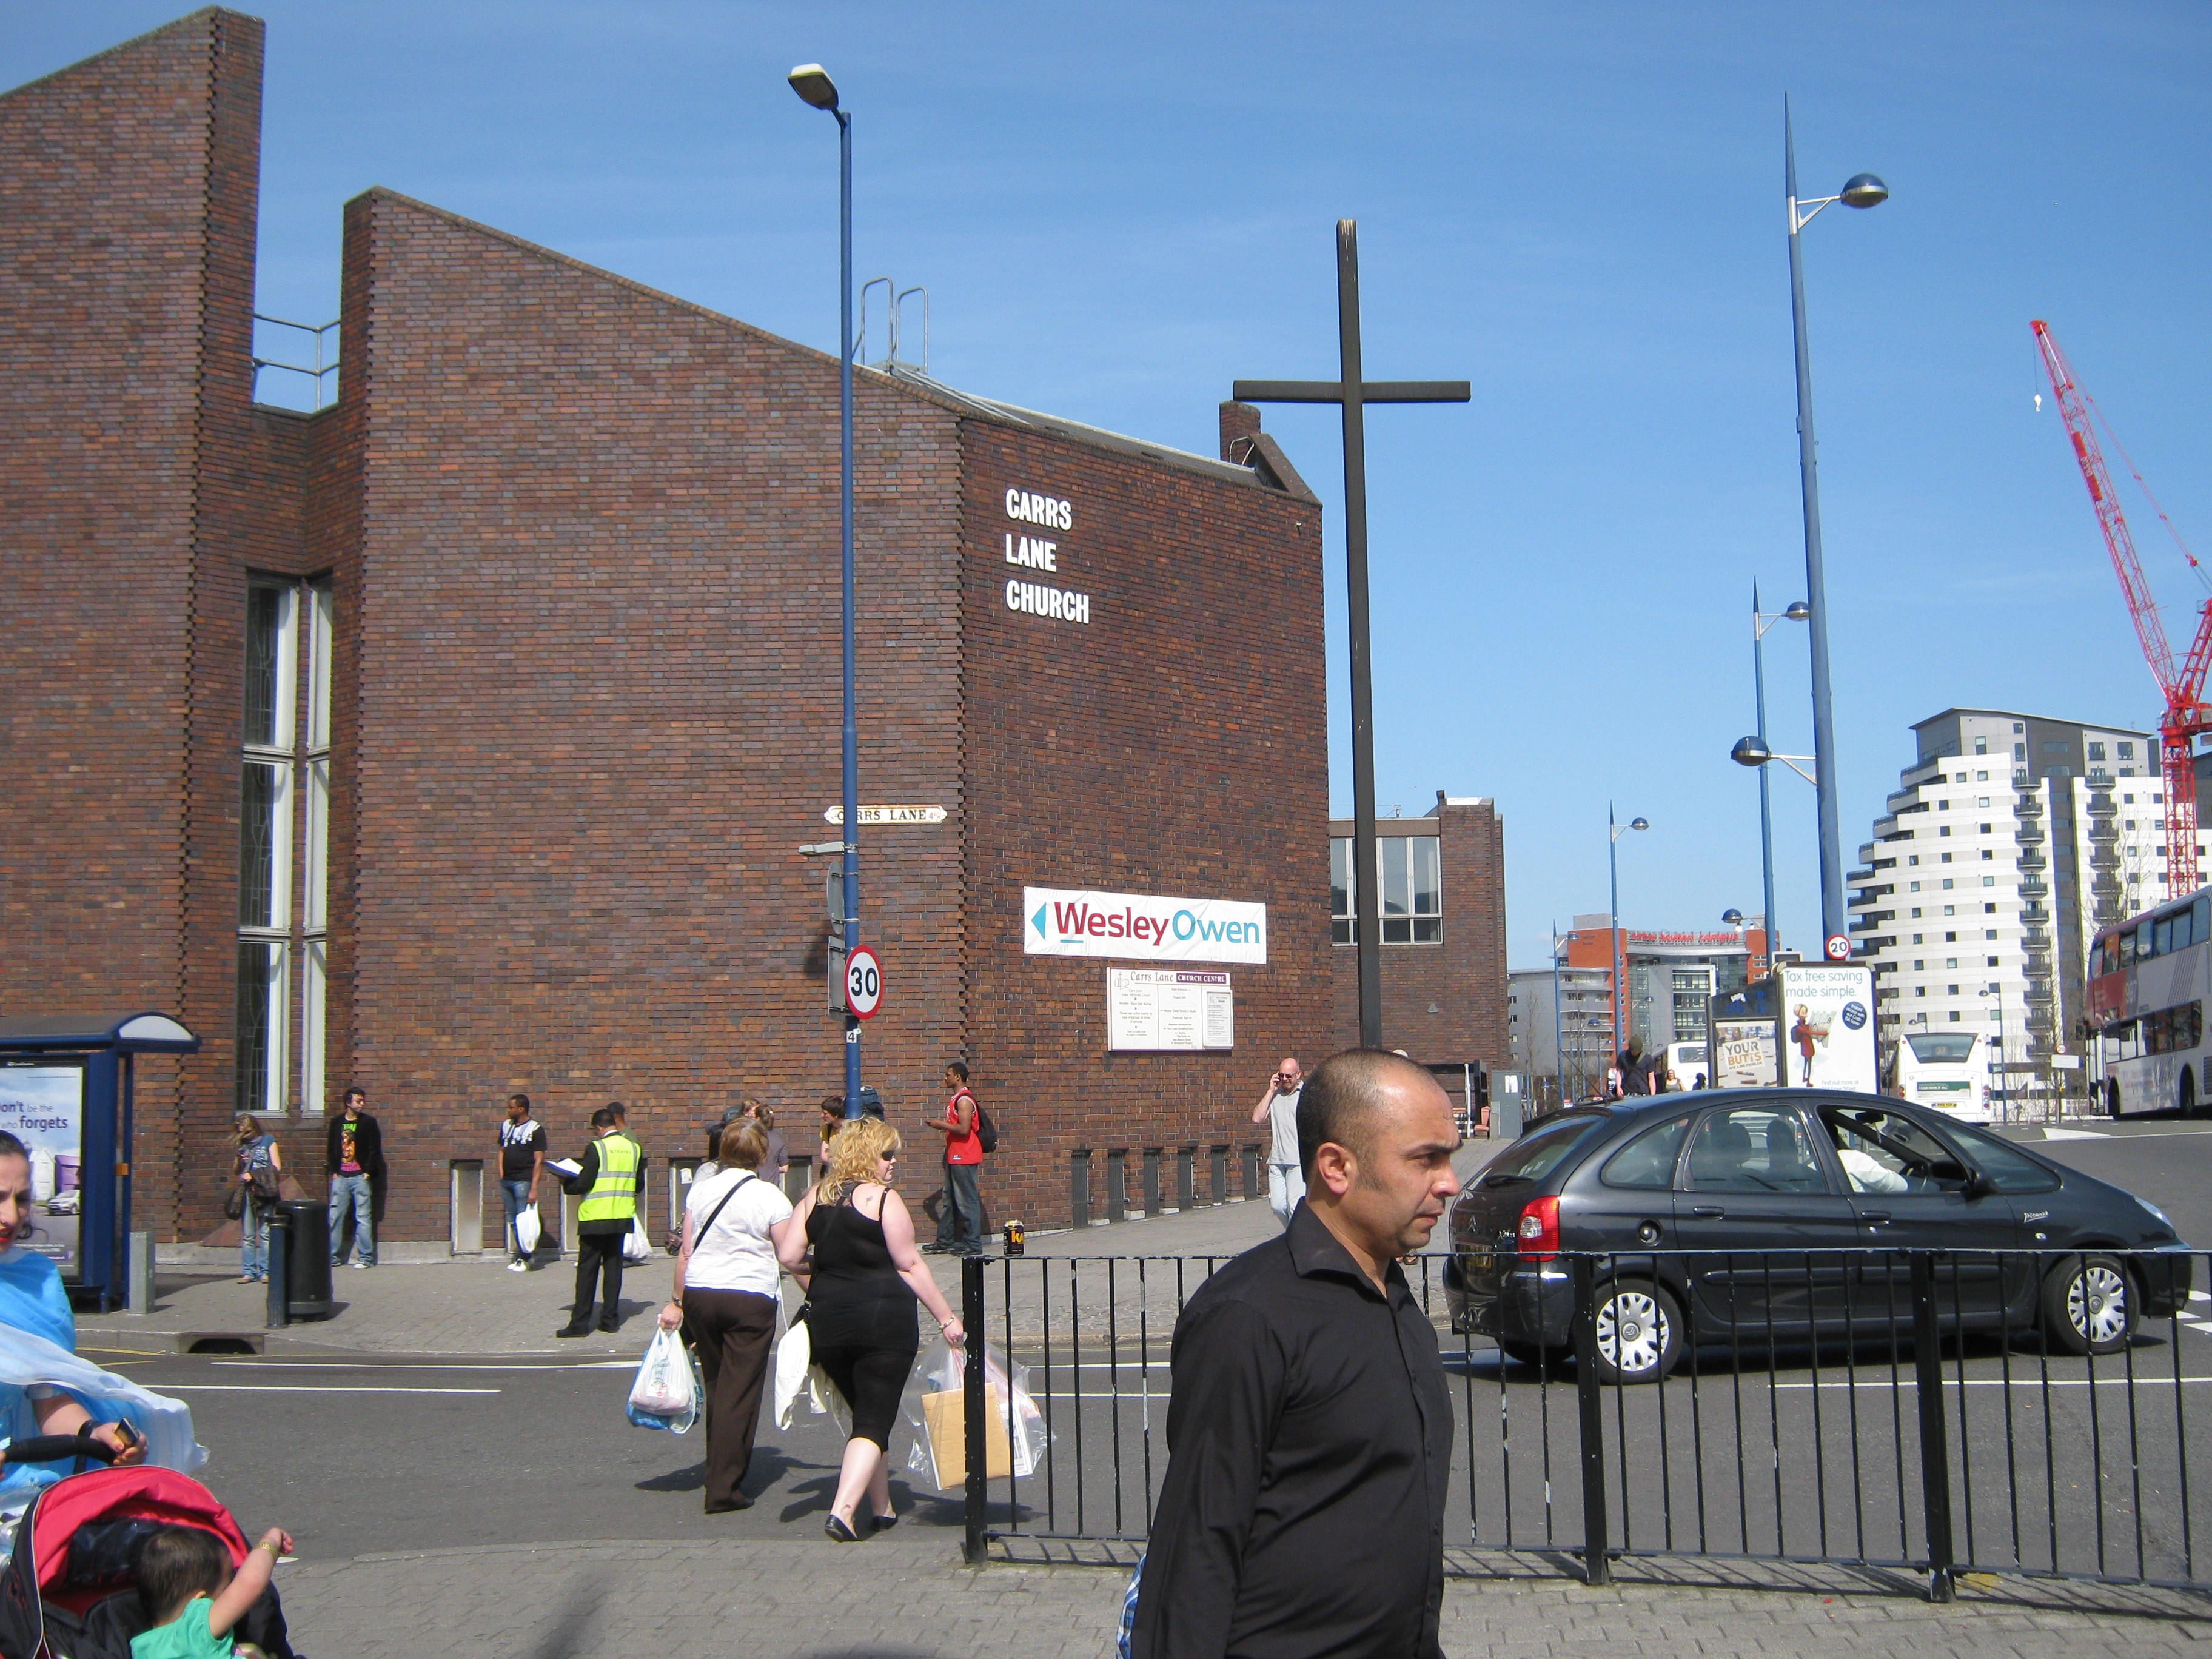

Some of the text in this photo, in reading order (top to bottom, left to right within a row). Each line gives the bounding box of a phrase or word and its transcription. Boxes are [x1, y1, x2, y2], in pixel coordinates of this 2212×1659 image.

[1005, 488, 1073, 531] CARRS
[1005, 533, 1057, 572] LANE
[1005, 579, 1090, 625] CHURCH
[837, 810, 880, 820] CRRS
[890, 810, 927, 820] LANE
[1054, 901, 1261, 946] Wesley Owen
[1831, 942, 1848, 953] 20
[850, 967, 878, 997] 30
[1130, 970, 1152, 982] Carrs
[1155, 971, 1174, 982] Lane
[1785, 970, 1863, 985] Tax free saving
[1786, 985, 1857, 999] made simple.
[848, 1032, 855, 1042] 4
[1725, 1041, 1760, 1055] YOUR
[1728, 1051, 1762, 1066] BUTTS
[27, 1104, 38, 1113] be
[39, 1104, 53, 1113] the
[20, 1115, 69, 1133] forgets
